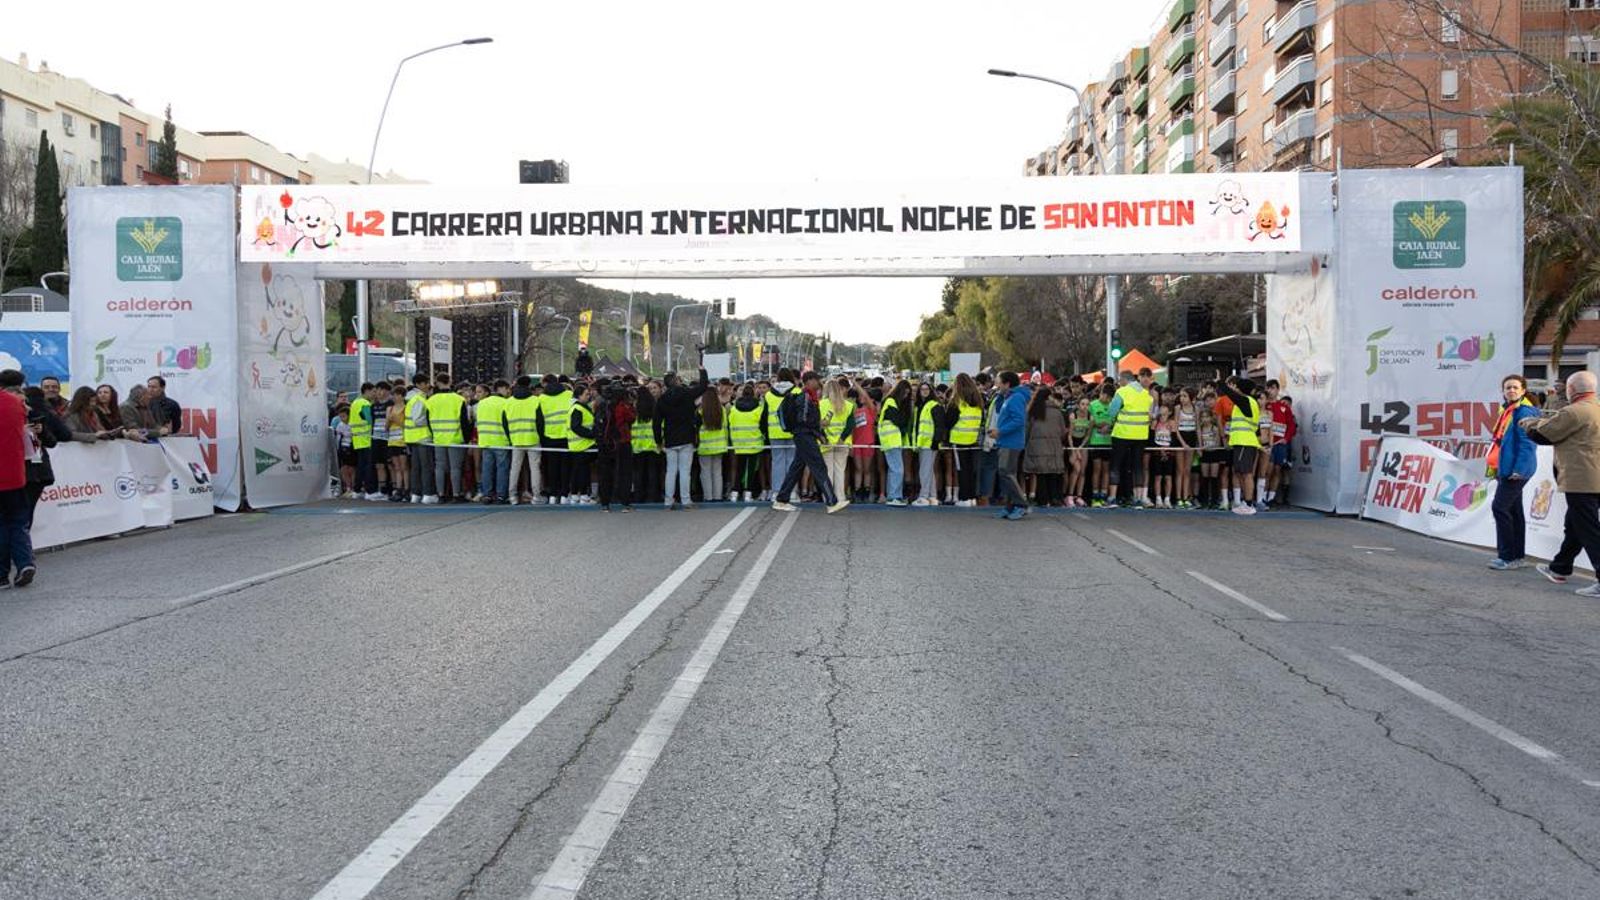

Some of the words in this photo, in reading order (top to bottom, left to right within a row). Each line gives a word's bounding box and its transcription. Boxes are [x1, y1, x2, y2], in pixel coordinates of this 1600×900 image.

[346, 210, 385, 237] 42
[391, 211, 522, 236] CARRERA
[530, 210, 643, 236] URBANA
[651, 207, 894, 235] INTERNACIONAL
[901, 205, 992, 232] NOCHE
[1000, 204, 1036, 231] DE
[1043, 202, 1099, 230] SAN
[1399, 241, 1424, 250] CAJA
[1425, 240, 1461, 250] RURAL
[120, 255, 144, 265] CAJA
[145, 255, 179, 265] RURAL
[1381, 285, 1476, 301] calderón
[106, 297, 192, 312] calderón
[1360, 401, 1410, 434] 42
[1417, 402, 1499, 436] SAN
[1380, 451, 1402, 478] 42
[1399, 454, 1435, 484] SAN
[40, 482, 102, 502] calderón
